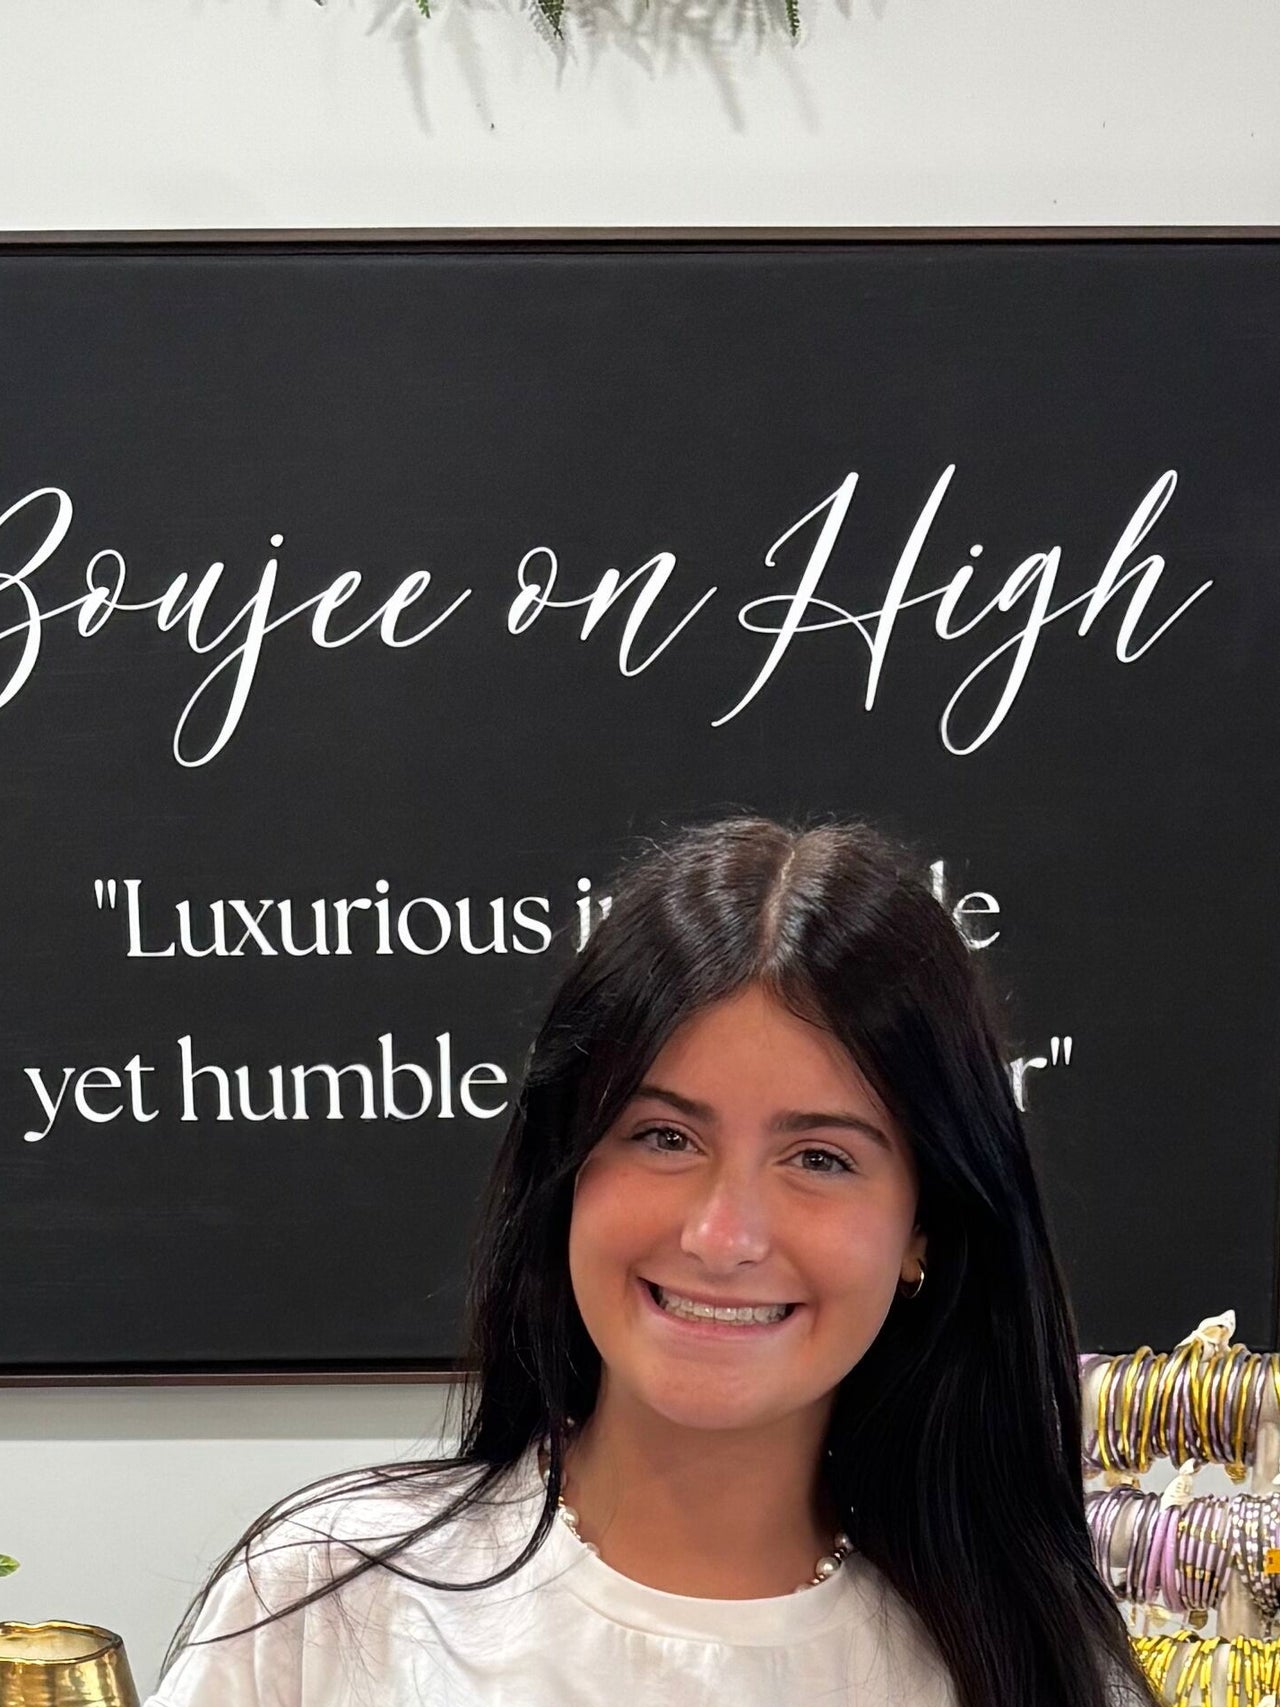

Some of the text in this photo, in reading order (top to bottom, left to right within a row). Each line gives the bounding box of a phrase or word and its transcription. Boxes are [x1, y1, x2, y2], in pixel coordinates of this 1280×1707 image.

[507, 546, 718, 677] on
[710, 463, 1214, 756] High
[94, 878, 552, 958] "Luxurious
[23, 1031, 509, 1143] yet humble
